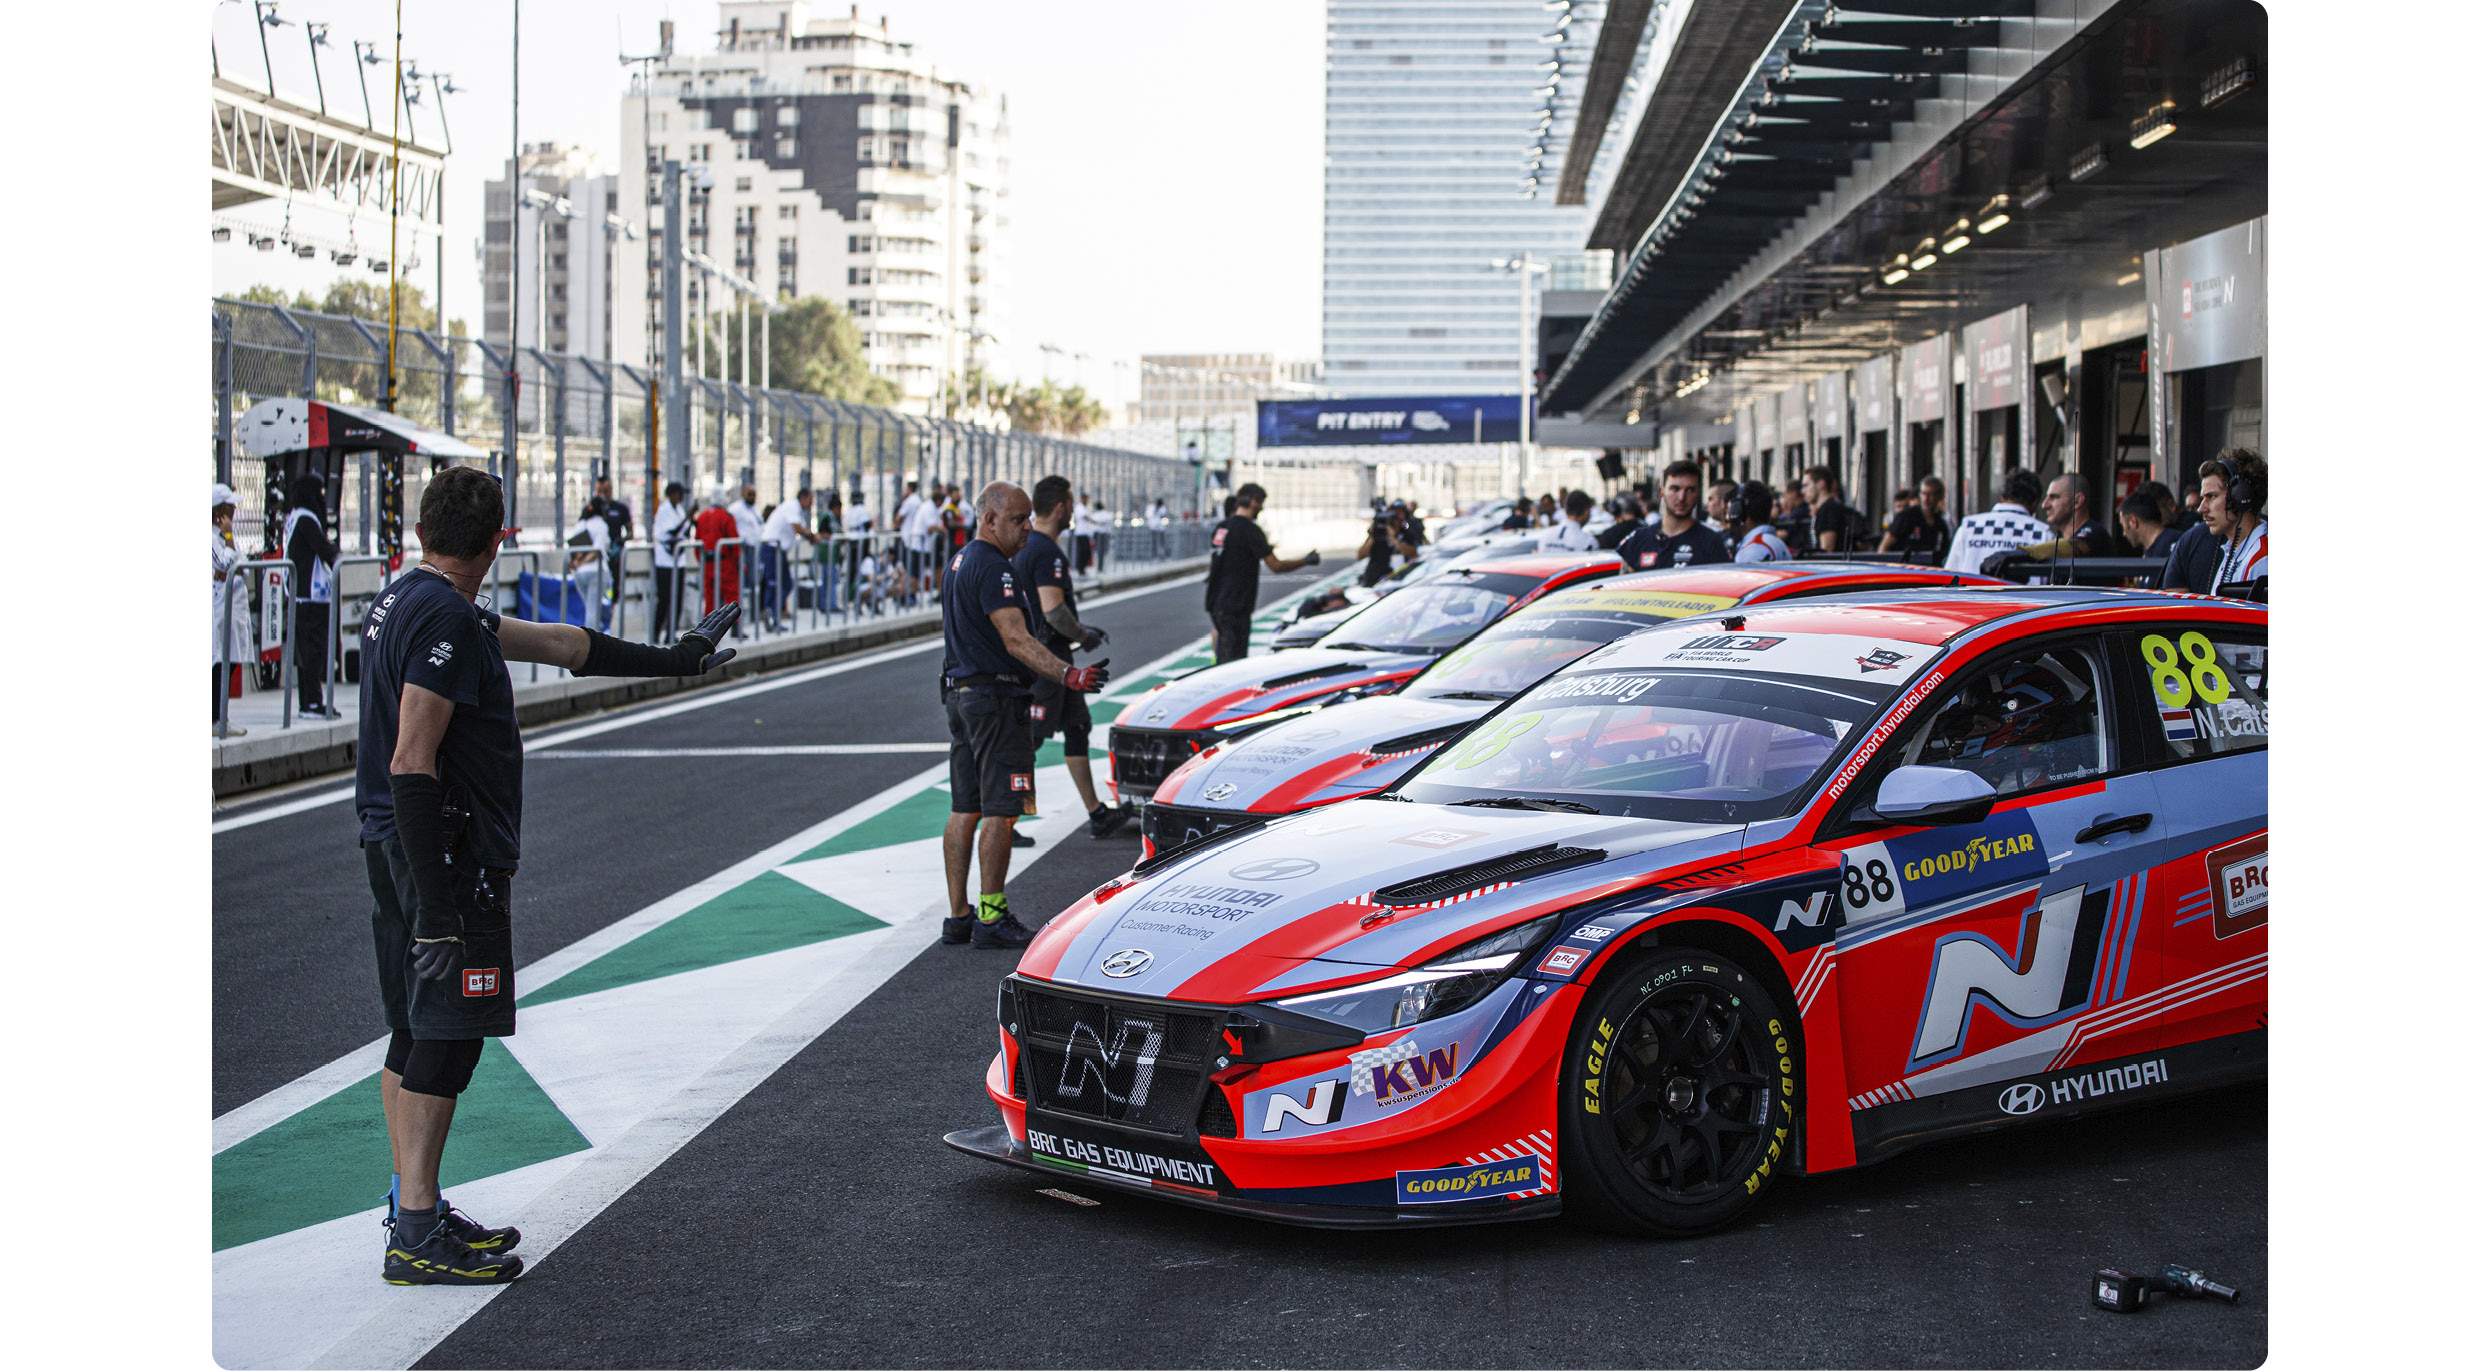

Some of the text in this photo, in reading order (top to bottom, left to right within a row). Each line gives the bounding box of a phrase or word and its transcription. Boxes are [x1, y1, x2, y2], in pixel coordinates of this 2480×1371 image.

[1317, 411, 1348, 430] PIT
[1348, 411, 1407, 430] ENTRY
[2141, 631, 2230, 708] 88
[1828, 671, 1944, 800] motorsport.hyundai.com
[1904, 833, 2035, 881] GOODYEAR
[1159, 885, 1284, 908] HYUNDAI
[1843, 859, 1895, 909] 88
[2232, 898, 2245, 908] GAS
[1121, 919, 1215, 941] Customer Racing
[1136, 900, 1254, 923] MOTORSPORT
[1574, 928, 1611, 939] OMP
[1774, 891, 1834, 932] N
[1553, 954, 1575, 964] BRC
[1912, 882, 2111, 1063] N
[1058, 1017, 1163, 1107] N
[1371, 1041, 1459, 1101] KW
[1585, 1017, 1614, 1114] EAGLE
[2051, 1058, 2168, 1104] HYUNDAI
[1262, 1078, 1349, 1133] N
[1377, 1076, 1462, 1108] kwsuspensions.de
[1744, 1018, 1794, 1195] GOODYEAR
[1028, 1129, 1214, 1185] BRC GAS EQUIPMENT
[1406, 1166, 1531, 1194] GOODYEAR
